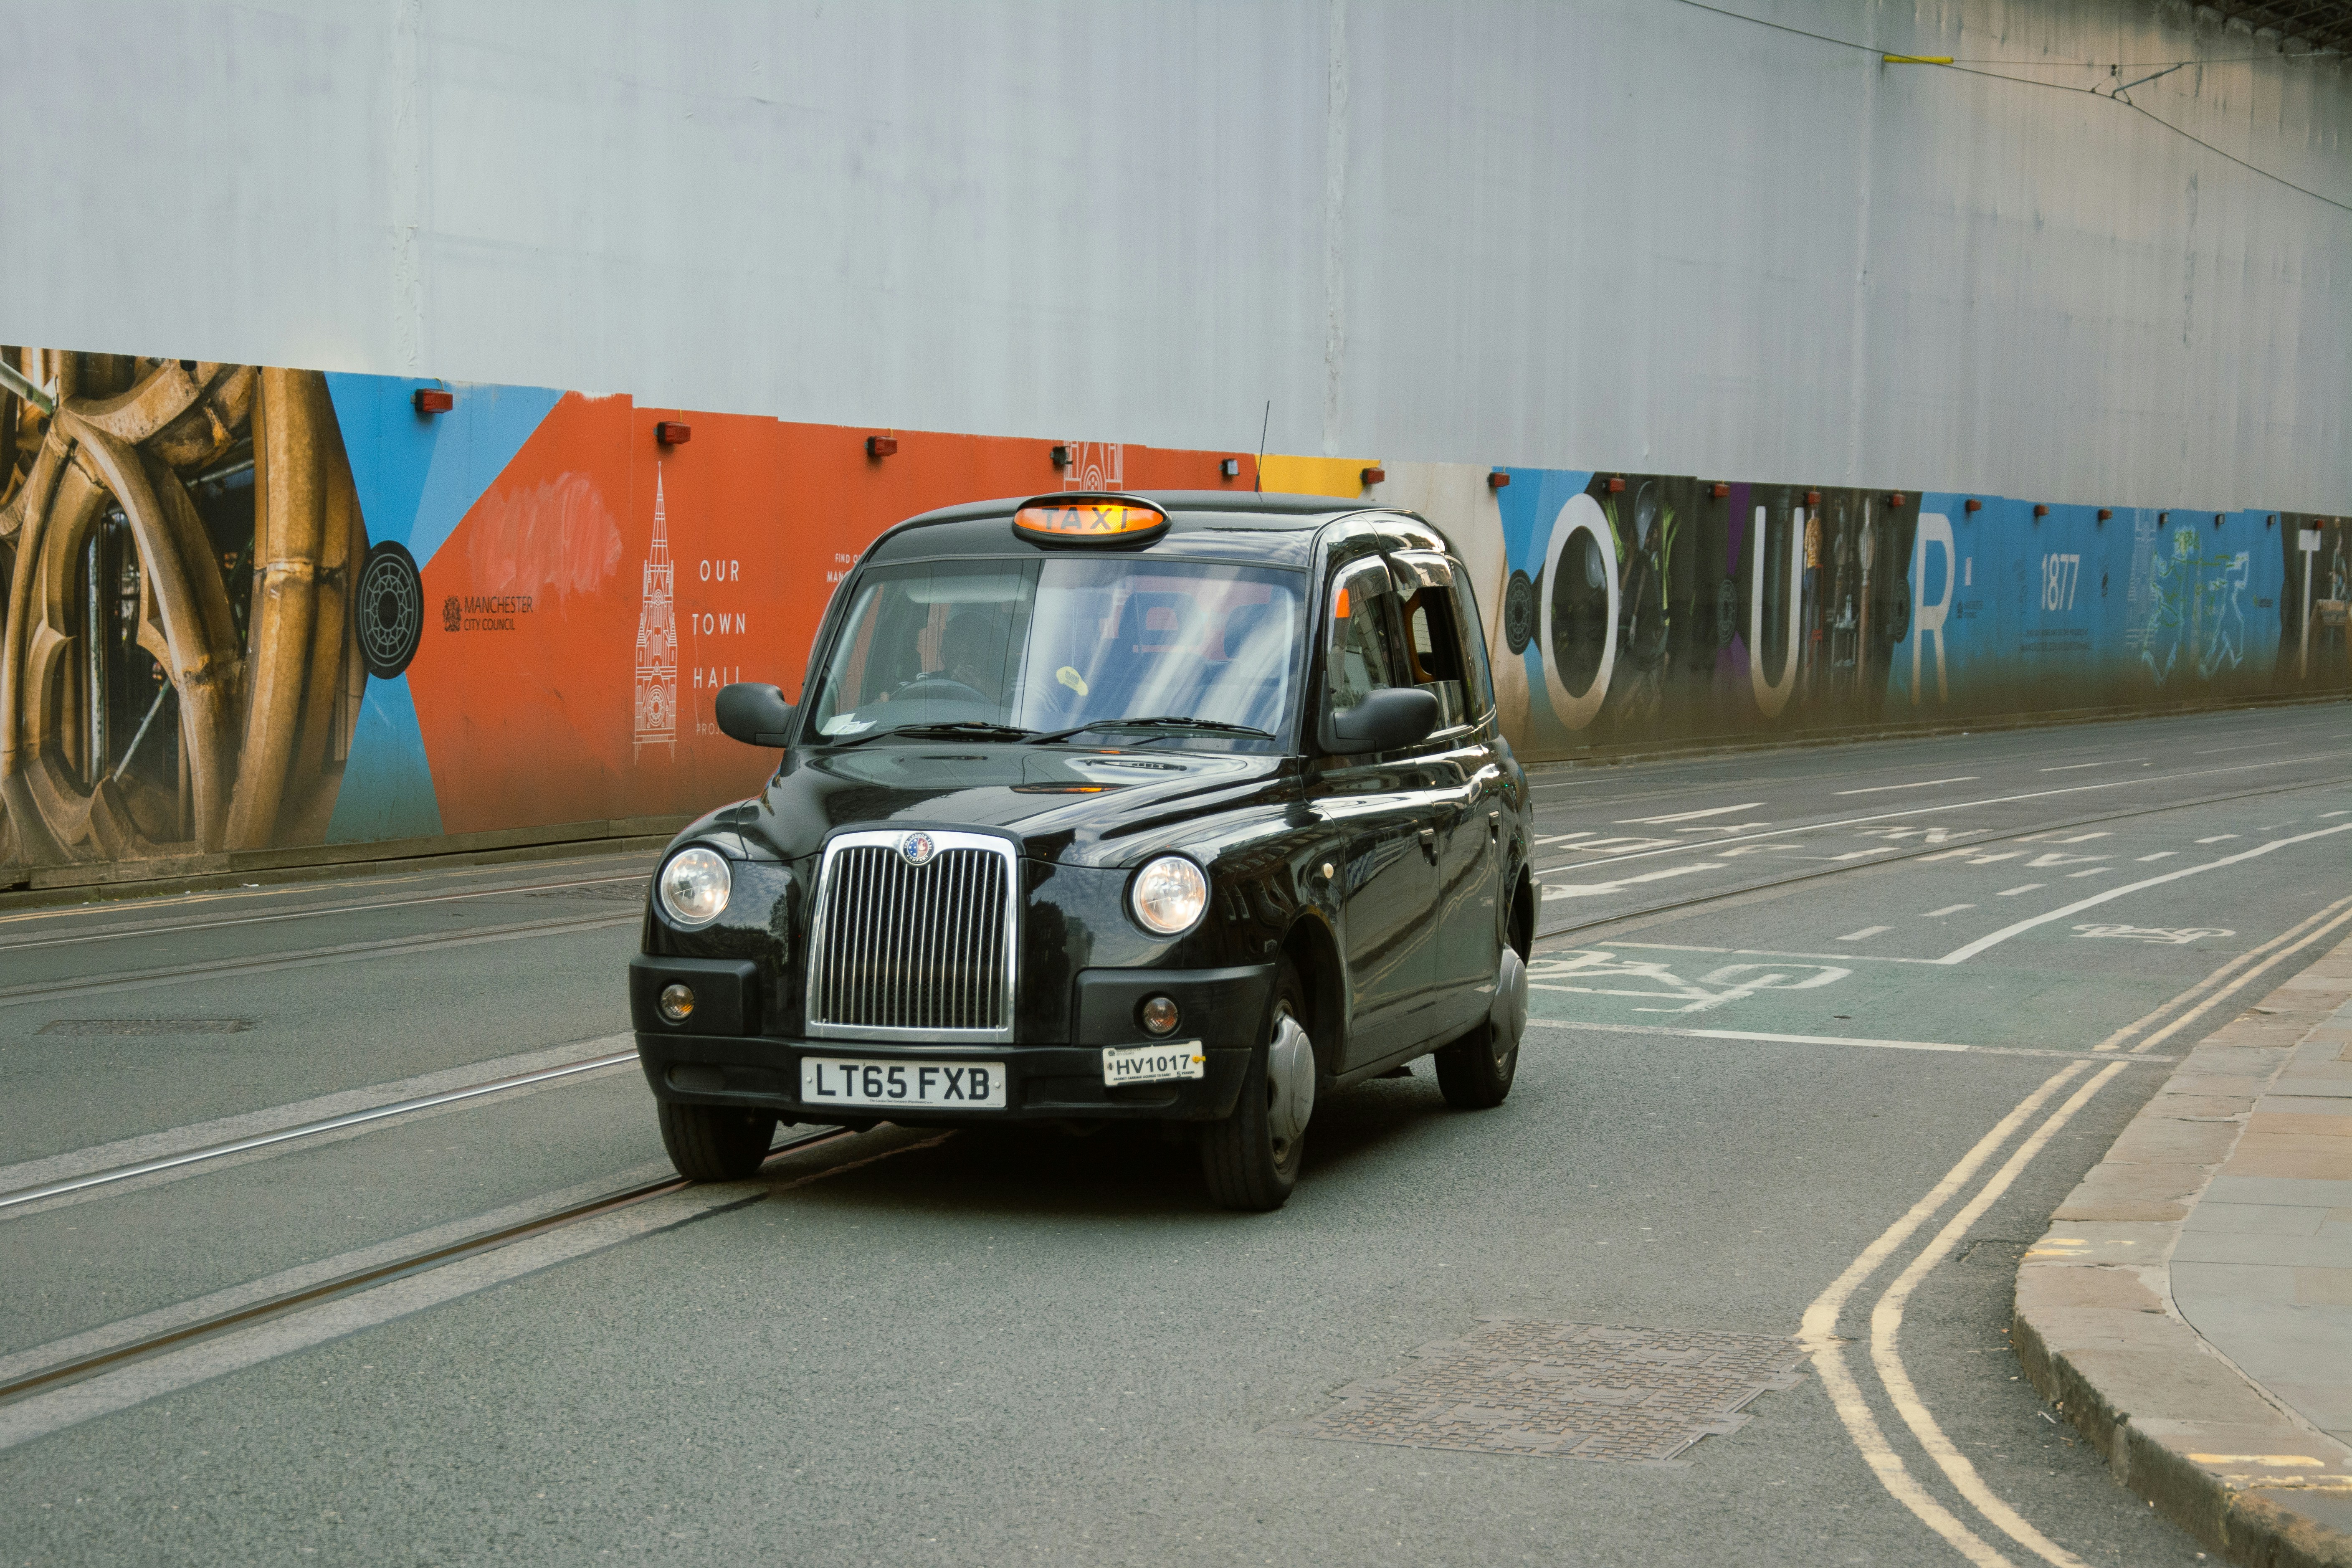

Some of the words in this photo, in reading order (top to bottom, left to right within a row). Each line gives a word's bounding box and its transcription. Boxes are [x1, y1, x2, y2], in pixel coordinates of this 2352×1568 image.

[1042, 507, 1127, 529] TAXI
[835, 553, 850, 563] FIND
[853, 554, 862, 563] O
[700, 560, 739, 582] OUR
[827, 570, 848, 583] MAN
[2042, 552, 2080, 611] 1877
[464, 596, 533, 613] MANCHESTER
[464, 618, 480, 631] CITY
[482, 618, 515, 631] COUNCIL
[692, 613, 745, 635] TOWN
[696, 723, 725, 735] PROJ
[1117, 1054, 1190, 1074] HV1017
[816, 1063, 907, 1098] LT65
[919, 1066, 990, 1100] FXB
